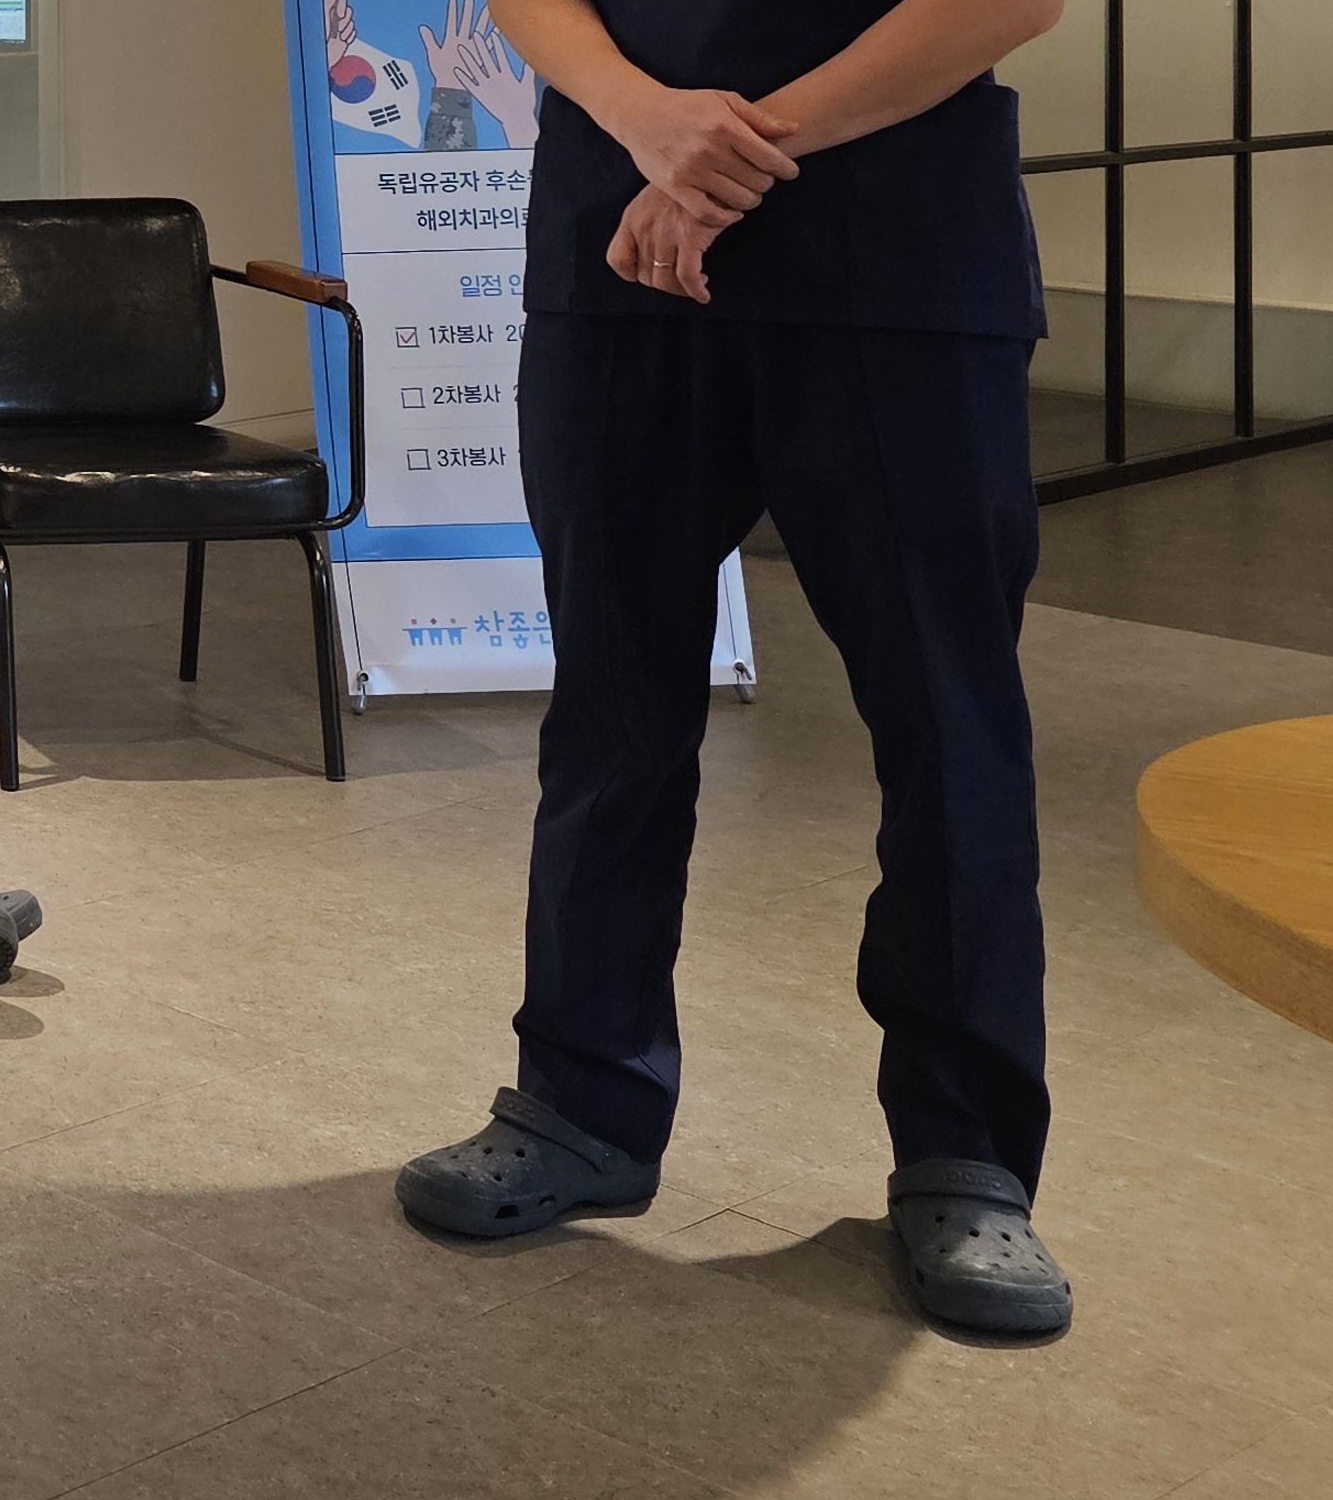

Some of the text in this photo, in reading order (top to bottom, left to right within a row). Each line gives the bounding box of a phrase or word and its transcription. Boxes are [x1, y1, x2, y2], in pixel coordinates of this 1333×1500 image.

[377, 168, 533, 196] 독립유공자 후손
[459, 274, 504, 298] 일정
[428, 323, 494, 345] 1차봉사
[432, 383, 502, 405] 2차봉사
[437, 446, 507, 468] 3차봉사
